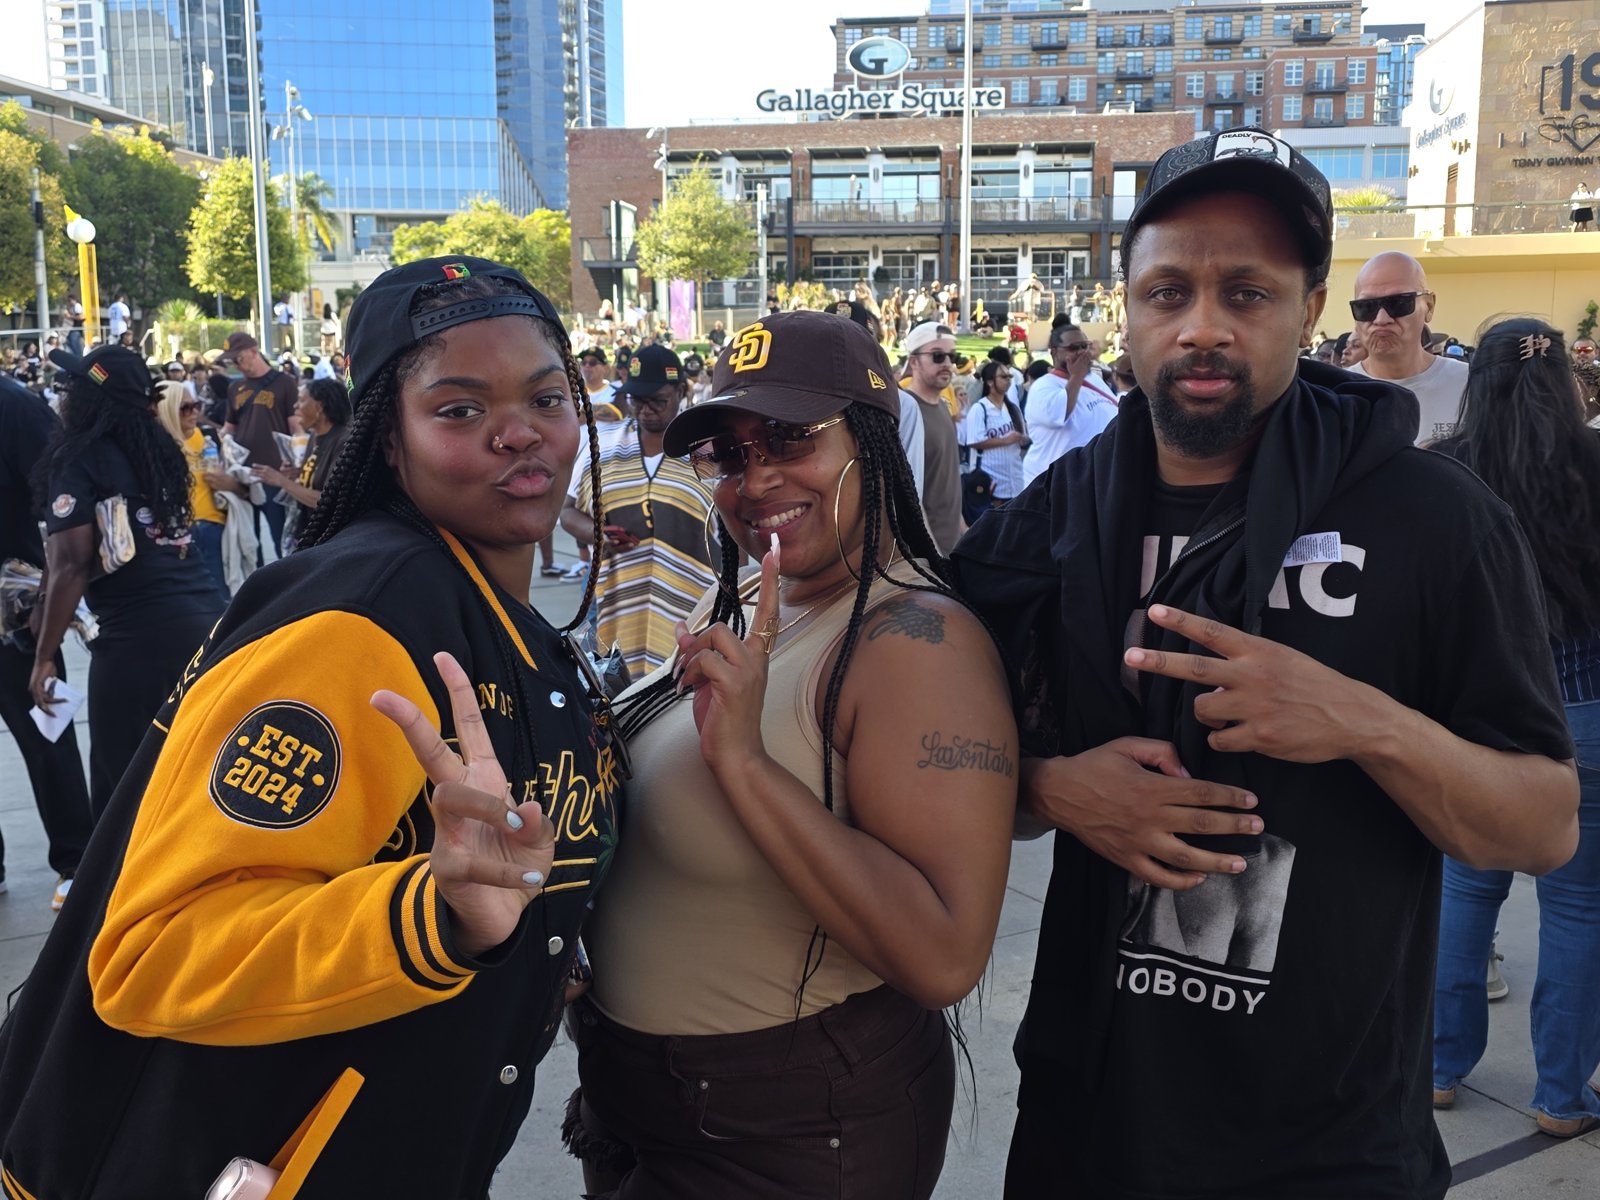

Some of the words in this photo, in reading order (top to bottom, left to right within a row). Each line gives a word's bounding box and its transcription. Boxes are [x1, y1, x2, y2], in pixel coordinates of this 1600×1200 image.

[756, 85, 894, 116] Gallagher
[901, 84, 1003, 115] Square
[1512, 158, 1543, 168] TONY
[1546, 156, 1594, 167] GWYNN
[728, 322, 773, 374] SD
[223, 756, 304, 815] 2024
